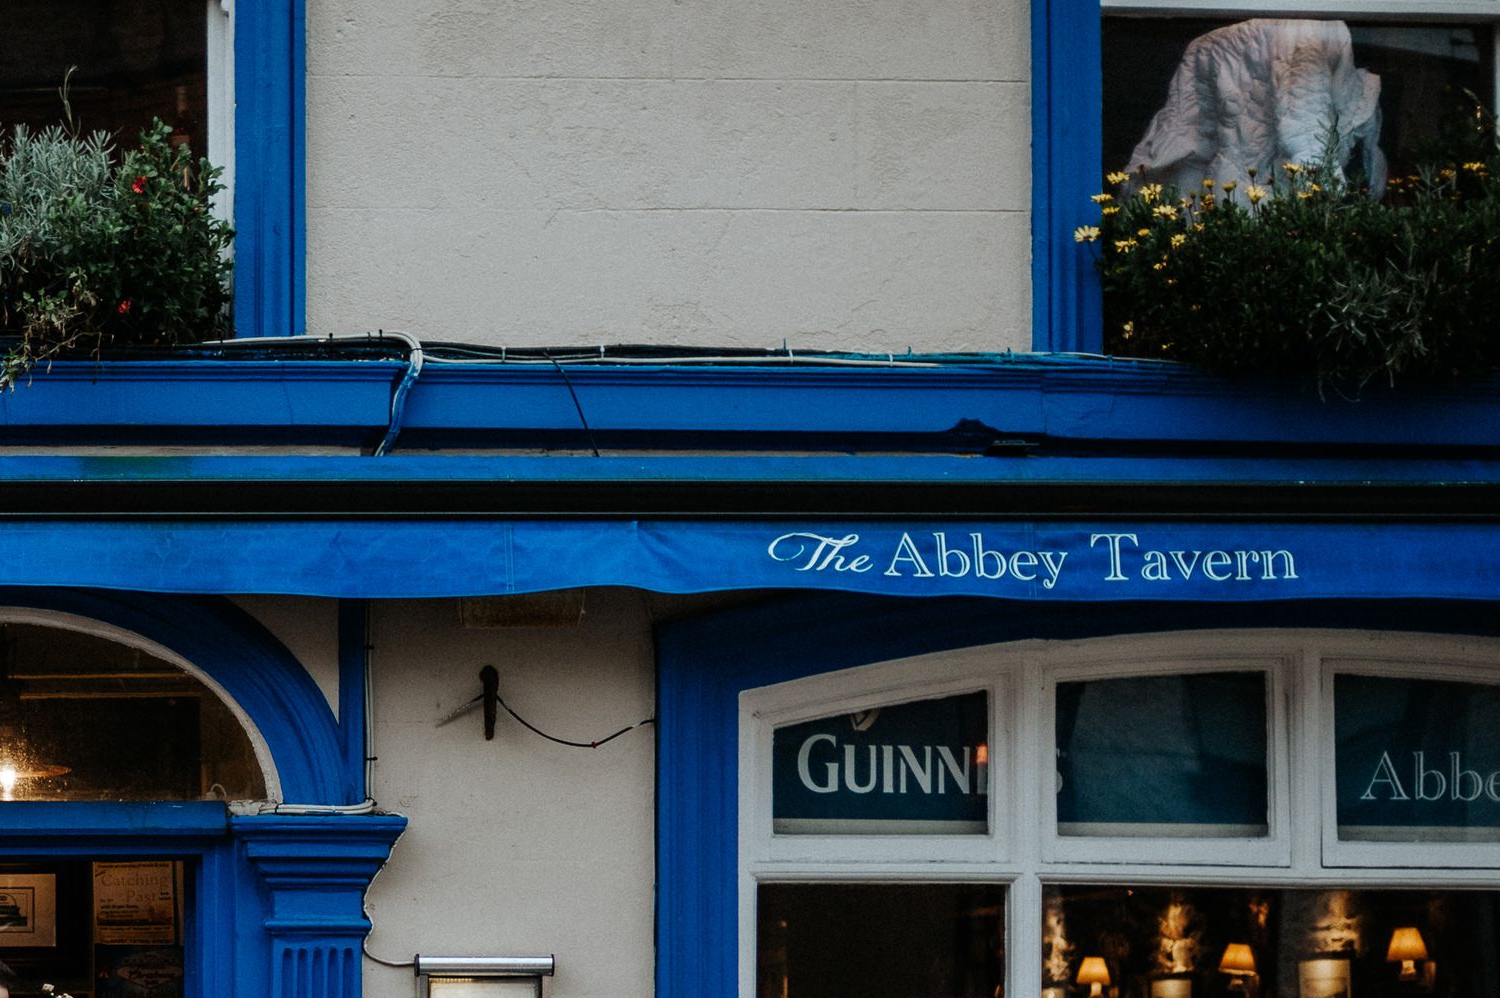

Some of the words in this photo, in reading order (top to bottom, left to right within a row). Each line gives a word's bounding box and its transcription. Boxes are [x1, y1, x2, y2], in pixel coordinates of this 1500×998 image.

[767, 532, 875, 573] The
[883, 532, 1069, 589] Abbey
[1090, 532, 1300, 581] Tavern
